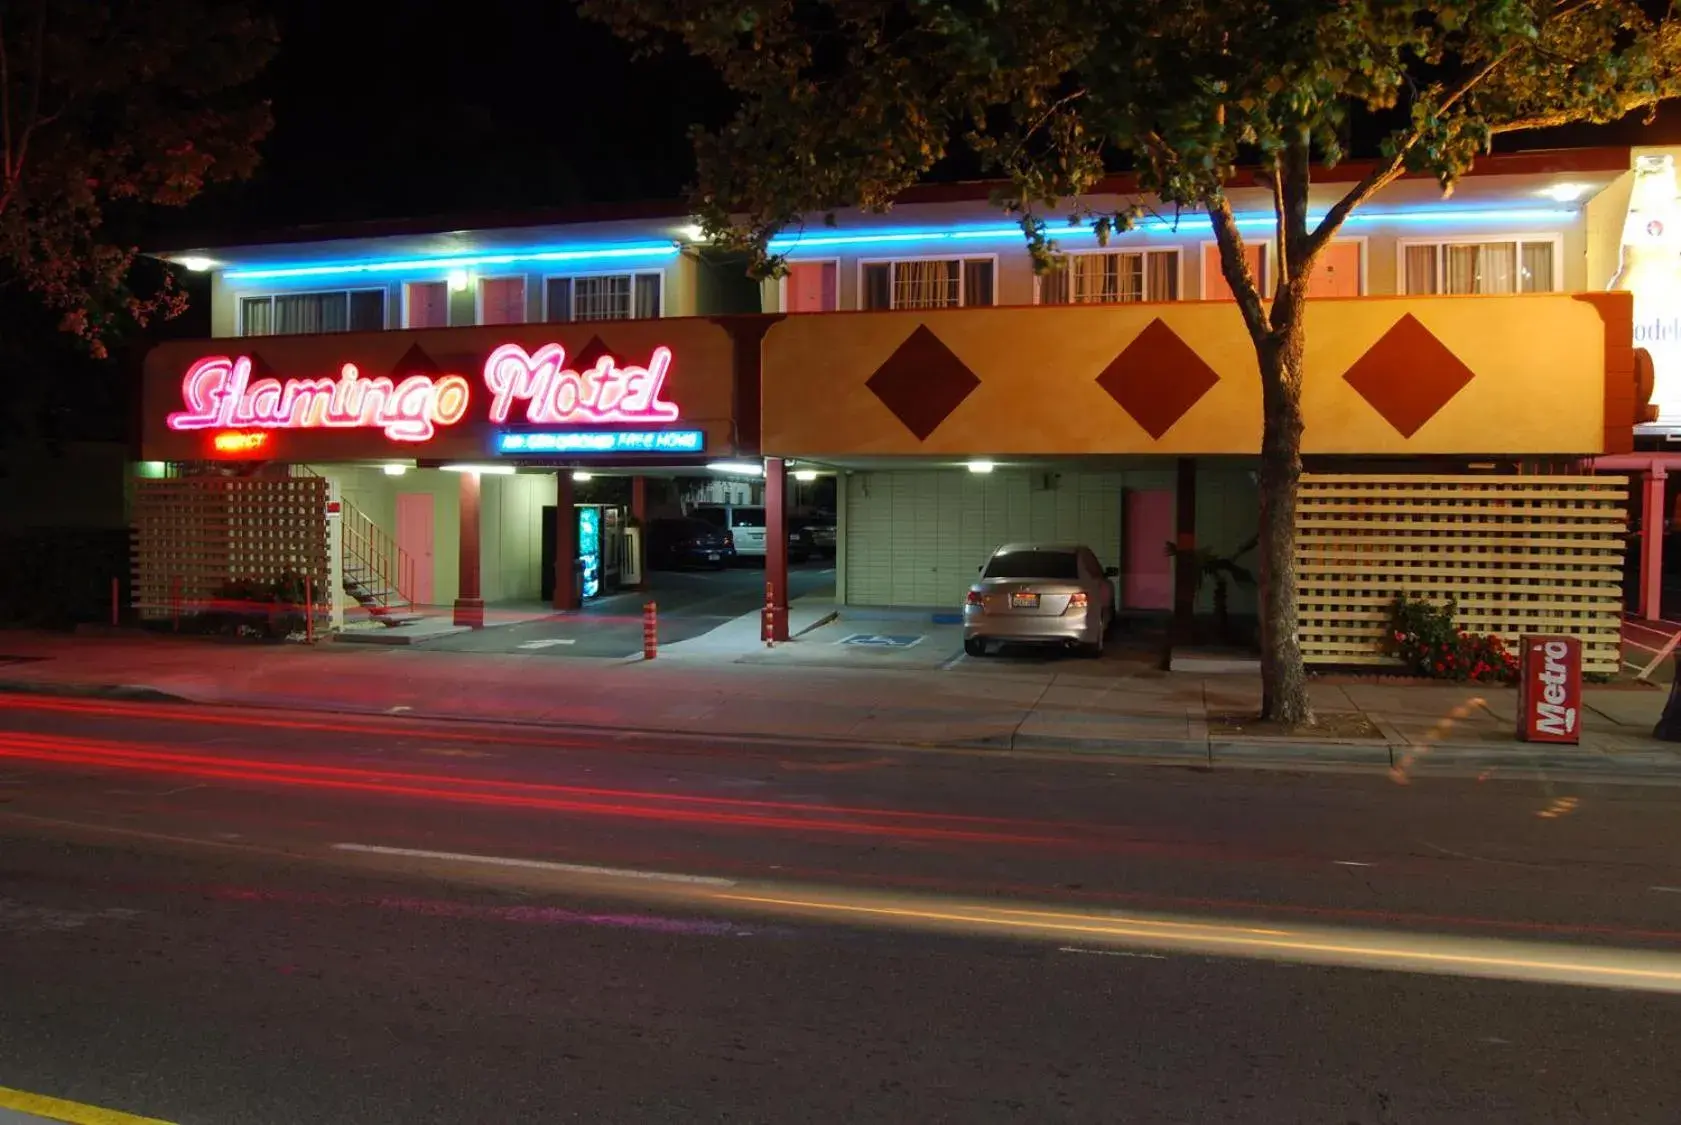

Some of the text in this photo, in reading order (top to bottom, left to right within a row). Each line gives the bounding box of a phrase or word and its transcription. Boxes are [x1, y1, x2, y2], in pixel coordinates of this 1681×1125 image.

[1634, 317, 1681, 341] odel
[166, 342, 679, 441] Flamingo Motel
[1535, 641, 1568, 736] Metro
